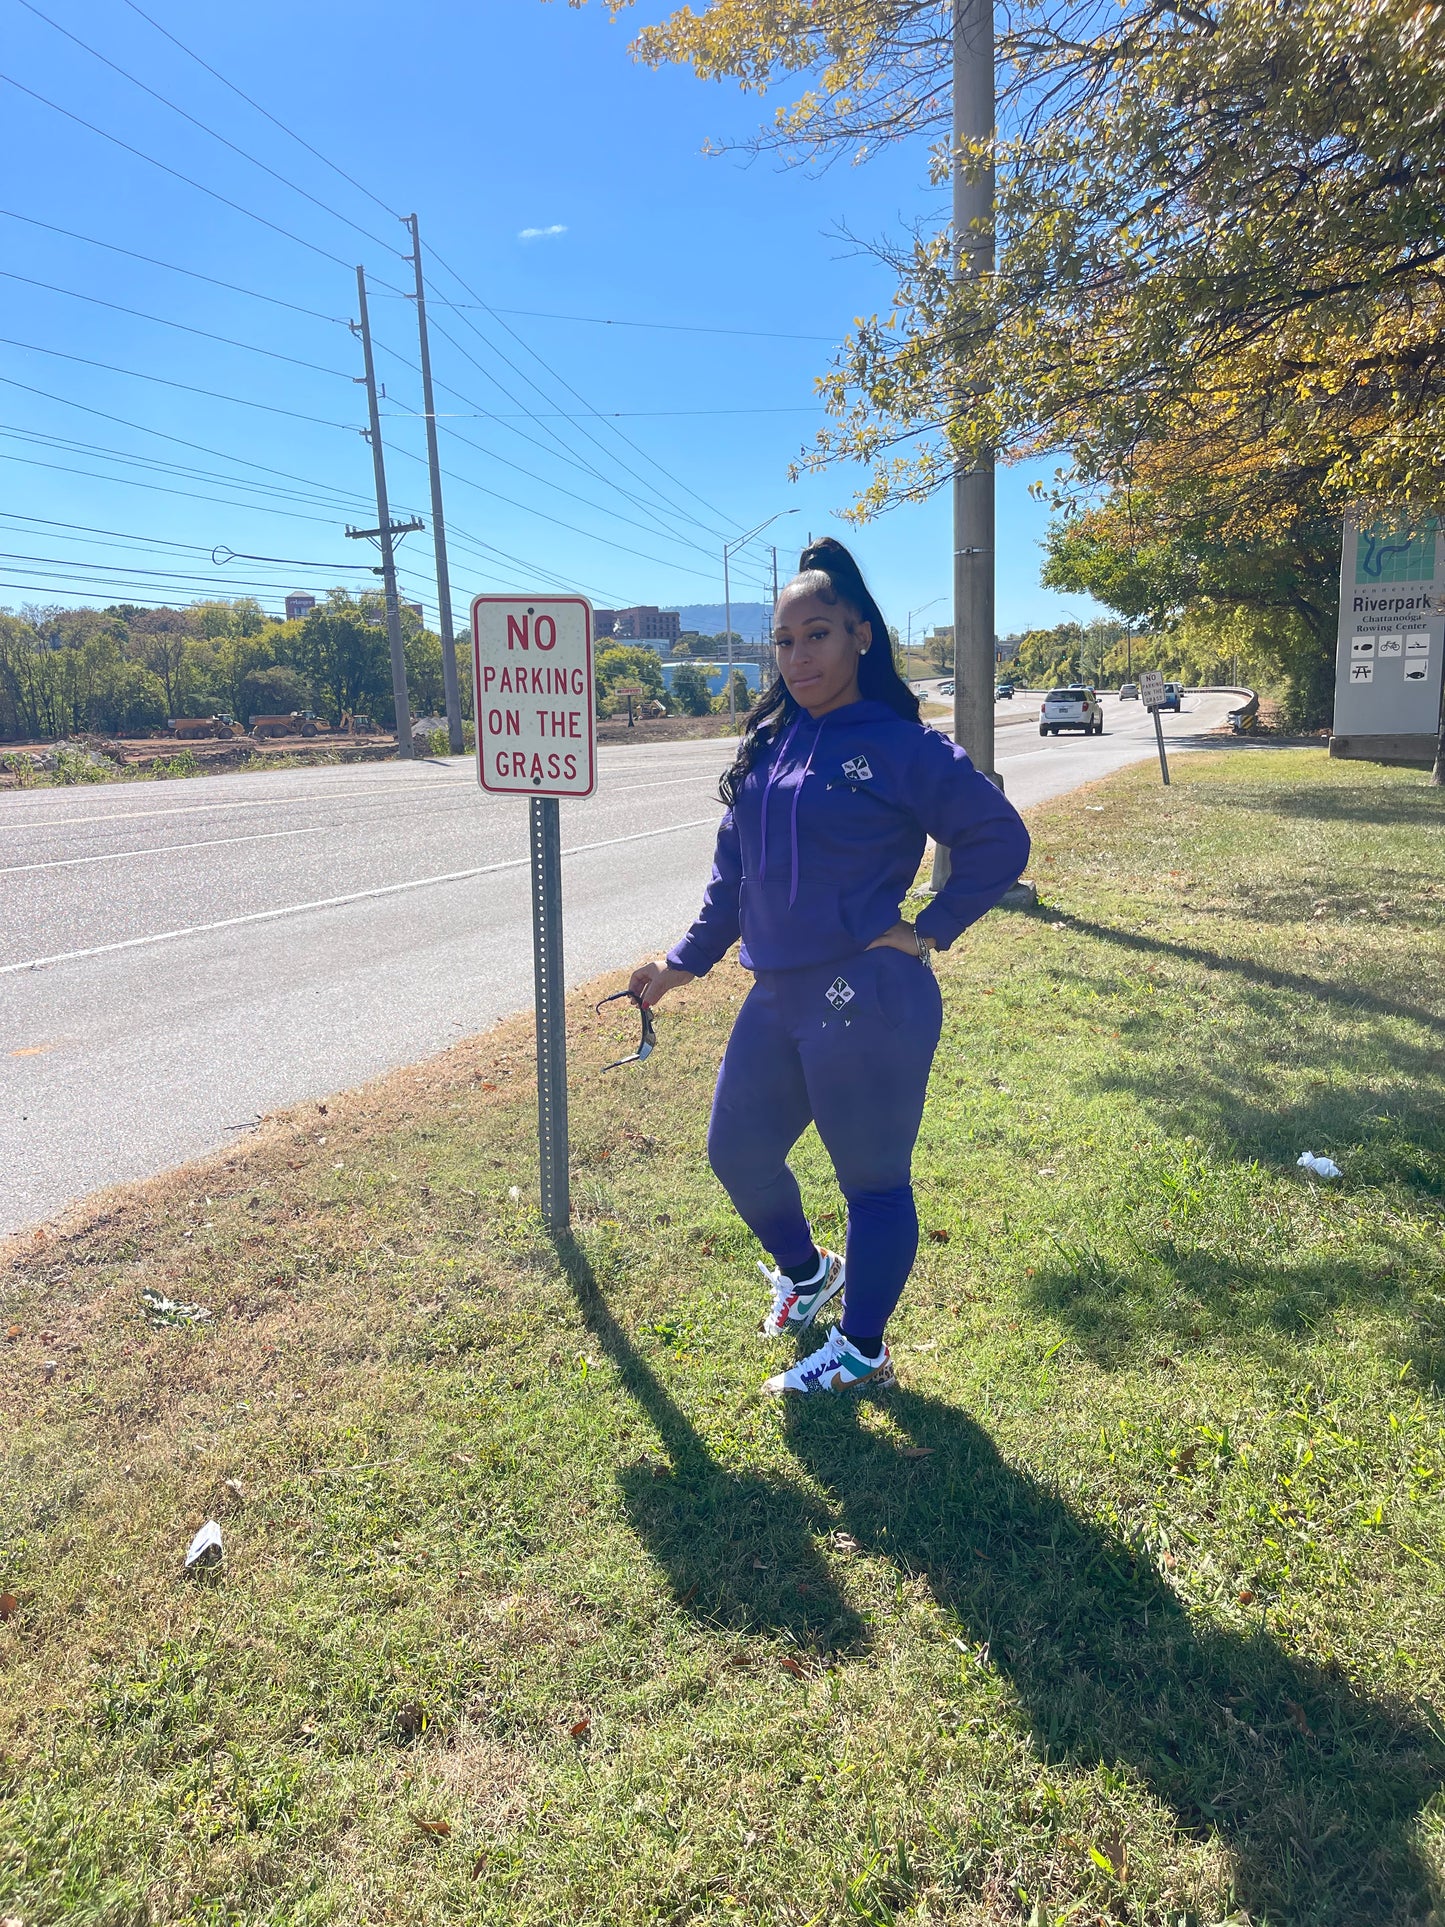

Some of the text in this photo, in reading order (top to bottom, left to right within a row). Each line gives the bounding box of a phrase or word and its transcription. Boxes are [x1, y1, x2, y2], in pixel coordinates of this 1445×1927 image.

[1353, 593, 1431, 613] Riverpark
[507, 615, 556, 651] NO
[1356, 622, 1427, 633] Rowing Center
[1362, 614, 1422, 623] Chattanooga
[484, 666, 584, 695] PARKING
[488, 709, 582, 738] ON THE
[496, 751, 577, 780] GRASS
